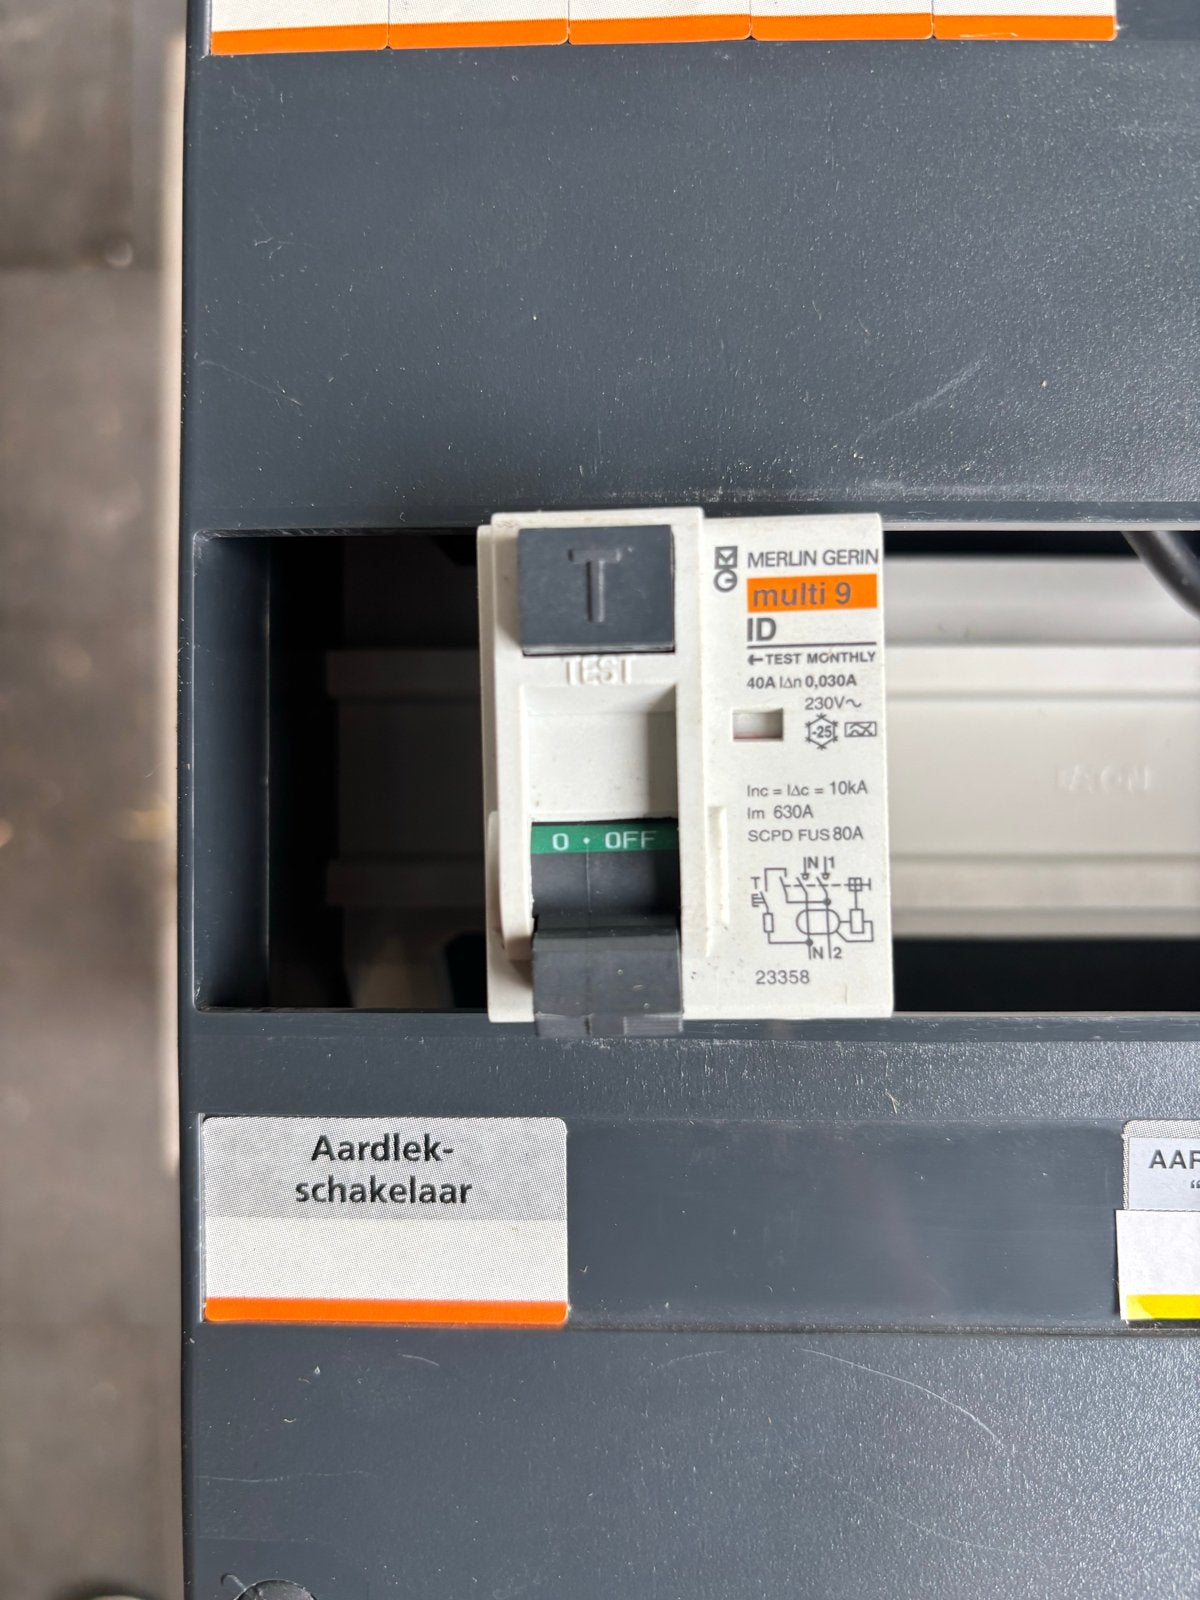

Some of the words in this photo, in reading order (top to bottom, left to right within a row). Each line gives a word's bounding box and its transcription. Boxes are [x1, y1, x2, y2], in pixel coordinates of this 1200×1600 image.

[747, 550, 817, 568] MERLIN
[822, 548, 879, 566] GERIN
[753, 582, 826, 607] multi
[835, 581, 852, 605] 9
[747, 617, 777, 642] ID
[766, 653, 802, 665] TEST
[806, 651, 876, 664] MONTHLY
[562, 656, 636, 686] TEST
[747, 676, 776, 690] 40A
[804, 674, 857, 690] 0,030A
[829, 779, 868, 795] 10kA
[773, 804, 814, 820] 630A
[604, 830, 657, 850] OFF
[747, 829, 793, 843] SCPD
[798, 828, 830, 842] FUS
[832, 825, 864, 842] 80A
[755, 969, 810, 985] 23358
[311, 1132, 454, 1163] Aardlek-
[295, 1174, 473, 1205] schakelaar
